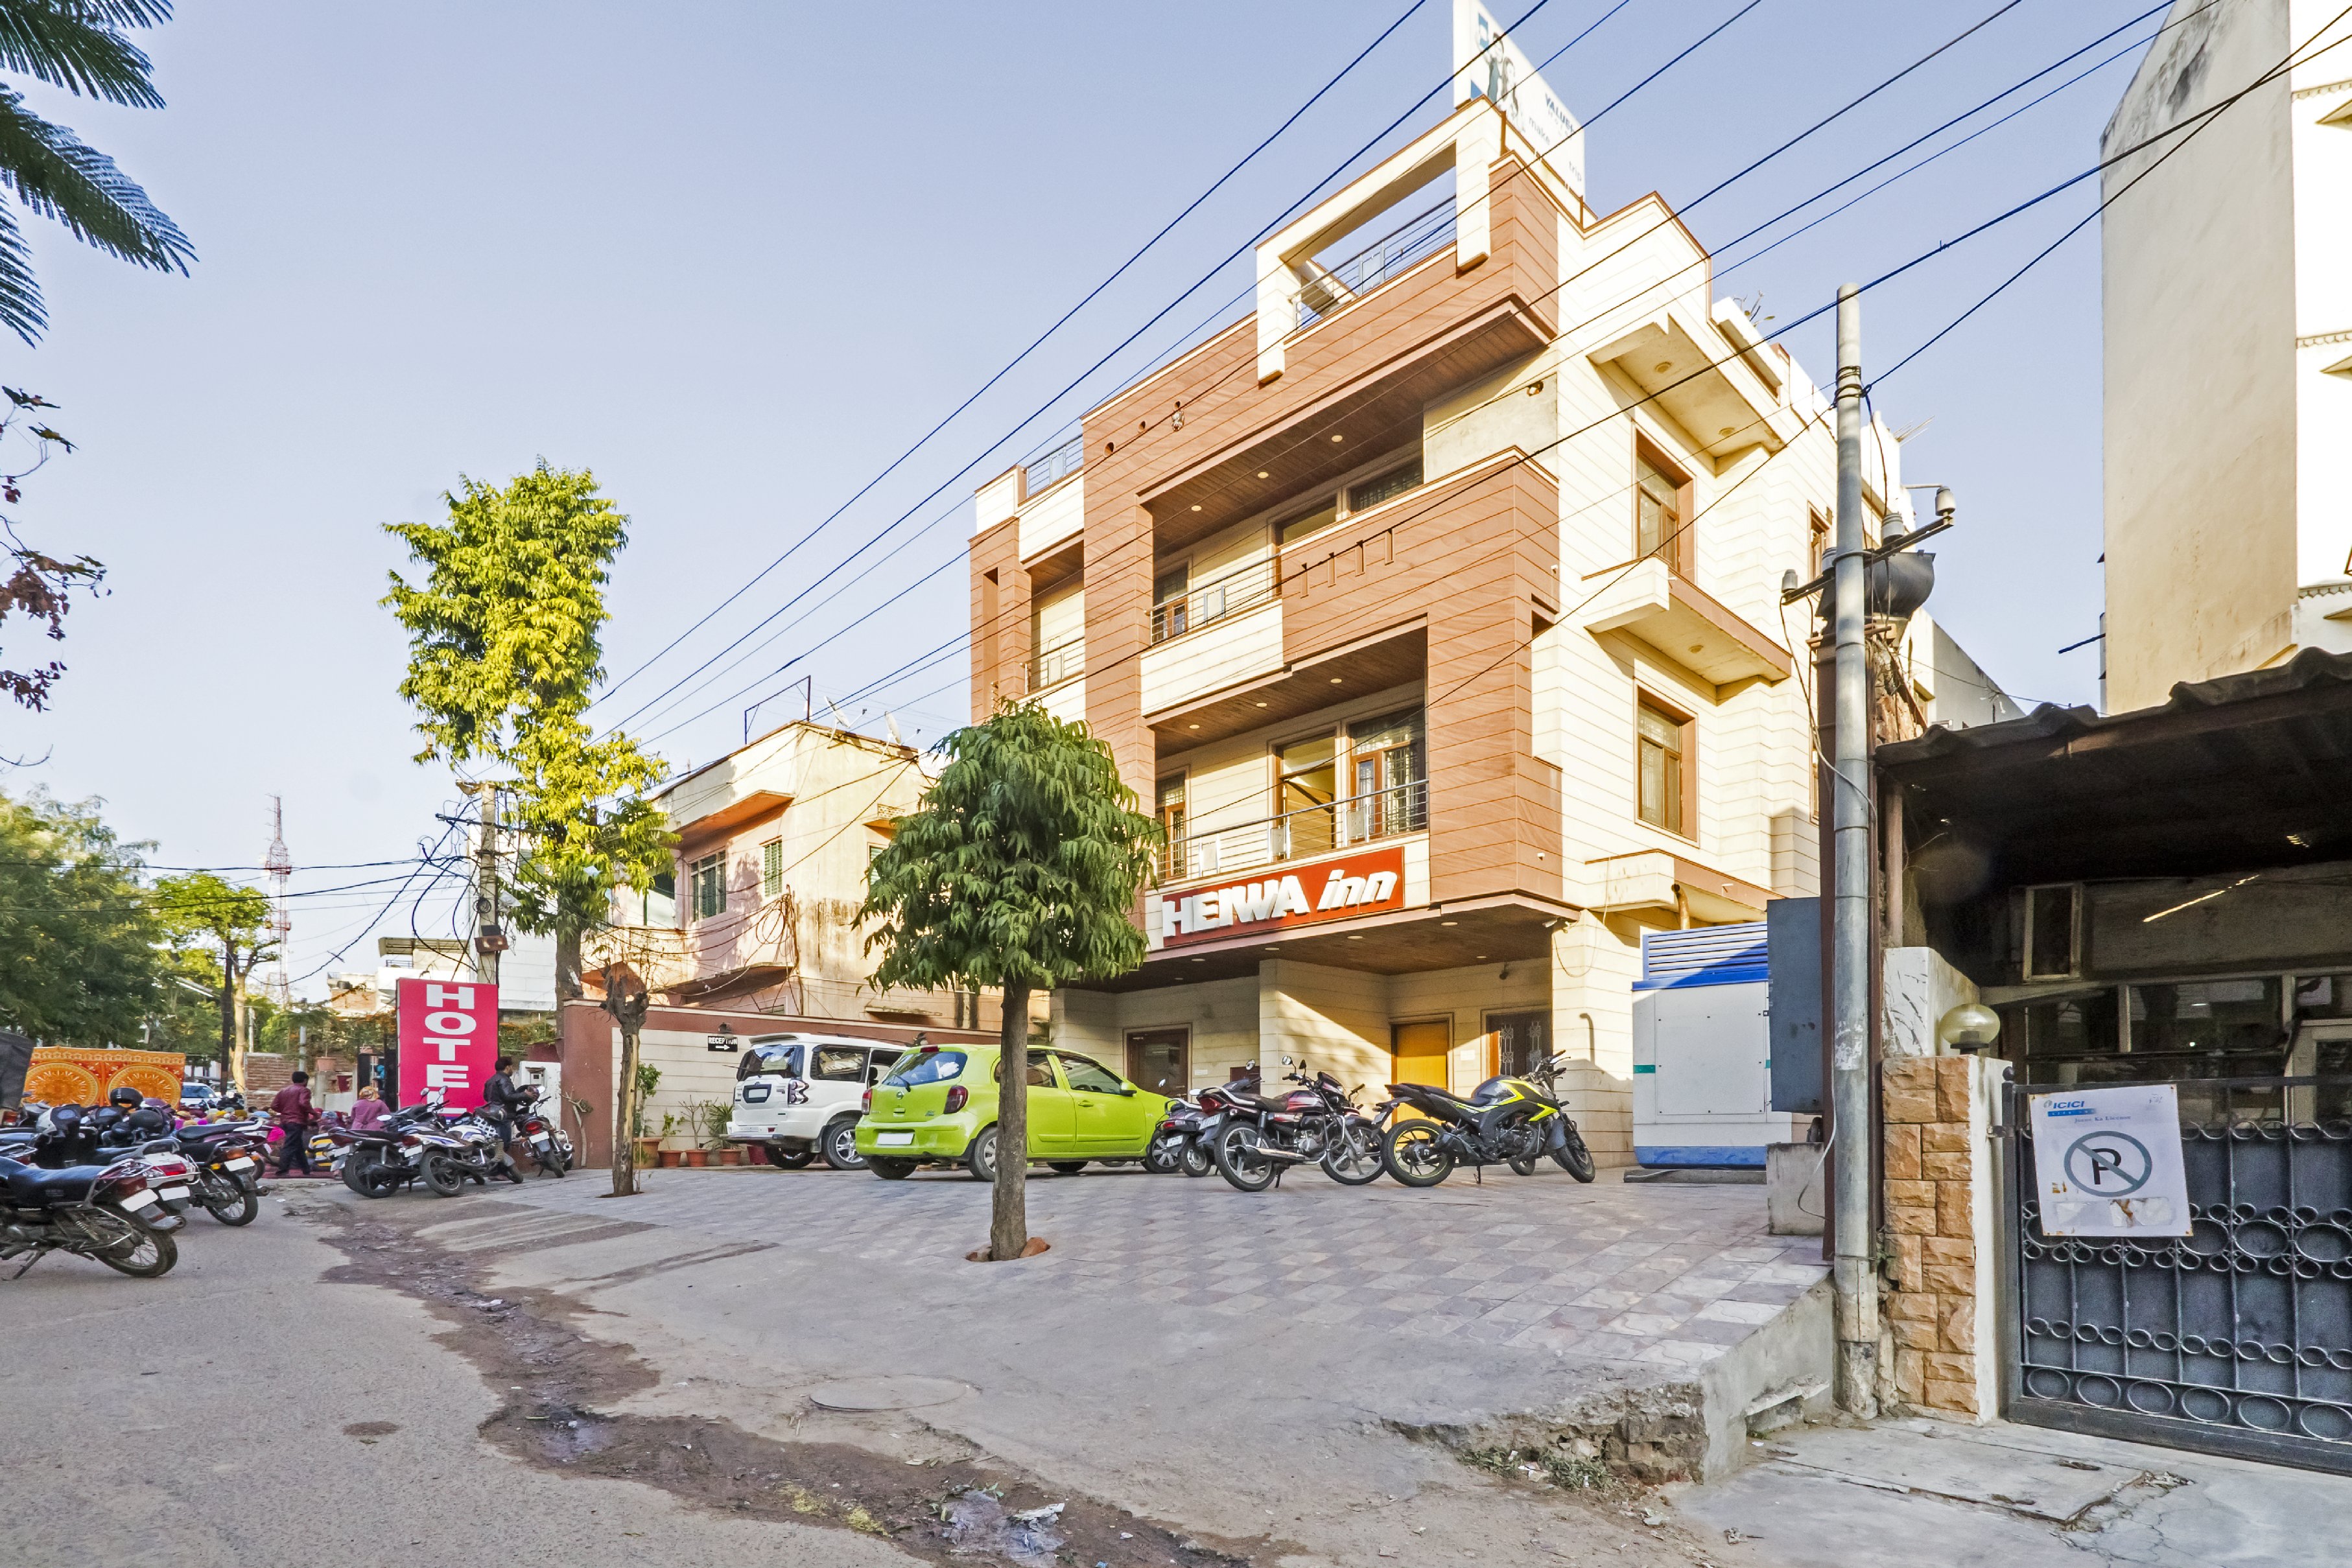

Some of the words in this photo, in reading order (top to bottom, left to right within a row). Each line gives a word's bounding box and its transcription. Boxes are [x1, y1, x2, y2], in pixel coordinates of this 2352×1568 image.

[1529, 117, 1550, 145] make
[1569, 161, 1582, 182] trip
[1162, 875, 1311, 937] HEIWA
[1317, 869, 1398, 911] inn
[423, 984, 477, 1114] HOTEL
[2053, 1101, 2085, 1109] ICICI
[2091, 1148, 2121, 1185] P
